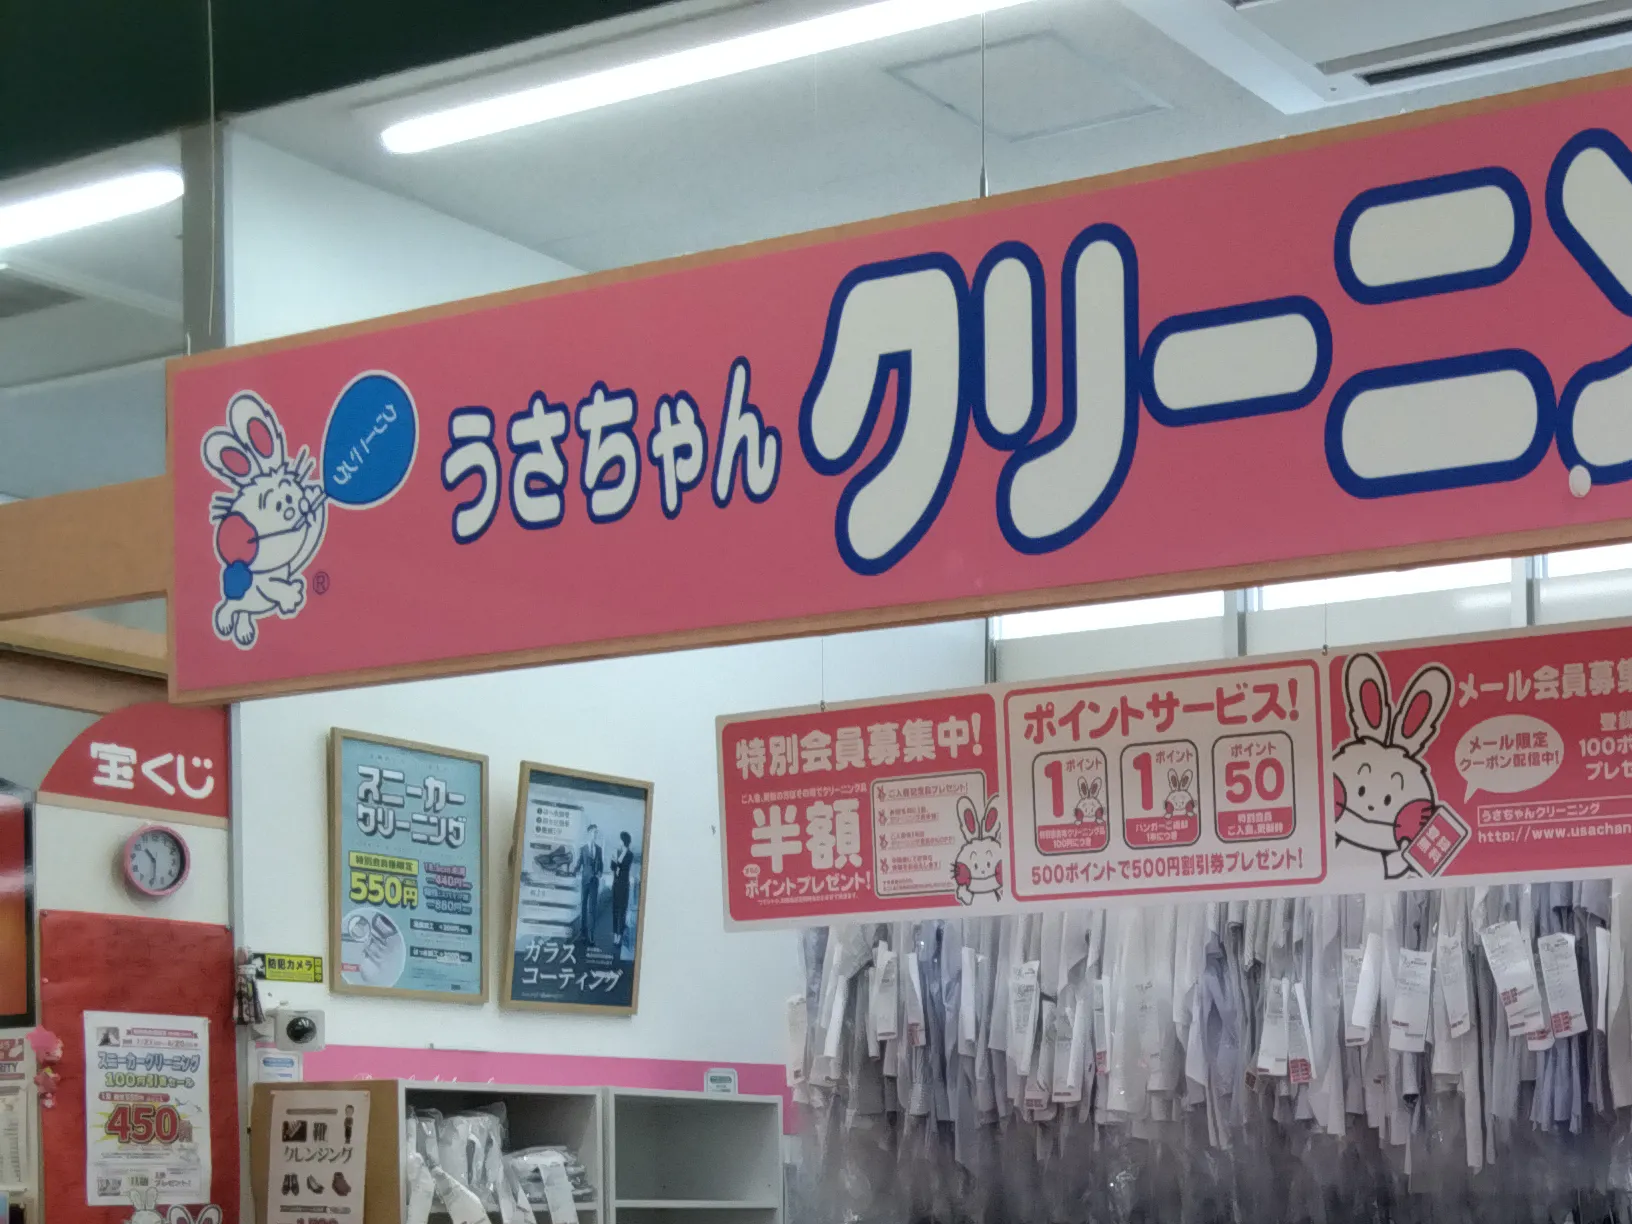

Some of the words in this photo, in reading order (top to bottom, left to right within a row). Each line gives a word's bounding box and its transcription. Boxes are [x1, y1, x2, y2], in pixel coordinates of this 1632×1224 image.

[441, 356, 780, 545] うさちゃん
[1023, 677, 1300, 745] ポイントサービス!
[735, 712, 983, 780] 特別会員募集中!
[1231, 741, 1276, 758] ポイント
[1459, 750, 1560, 773] クーポン配信中!
[1468, 730, 1548, 753] メール限定
[90, 742, 214, 799] 宝くじ
[357, 765, 466, 812] スニーカー
[1044, 760, 1064, 818] 1
[1065, 756, 1102, 772] ポイント
[1133, 751, 1153, 811] 1
[1155, 748, 1193, 765] ポイント
[1225, 757, 1285, 804] 50
[357, 803, 467, 848] クリーニング
[1480, 802, 1600, 824] うさちゃんクリーニング
[751, 798, 863, 874] 半額
[745, 871, 872, 899] ポイントプレゼント!
[1031, 848, 1304, 886] 500ポイントで500円割引券プレゼント!
[349, 871, 418, 909] 550円
[524, 938, 577, 965] ガラス
[522, 967, 623, 993] コーティング
[283, 1145, 353, 1164] クレンジング
